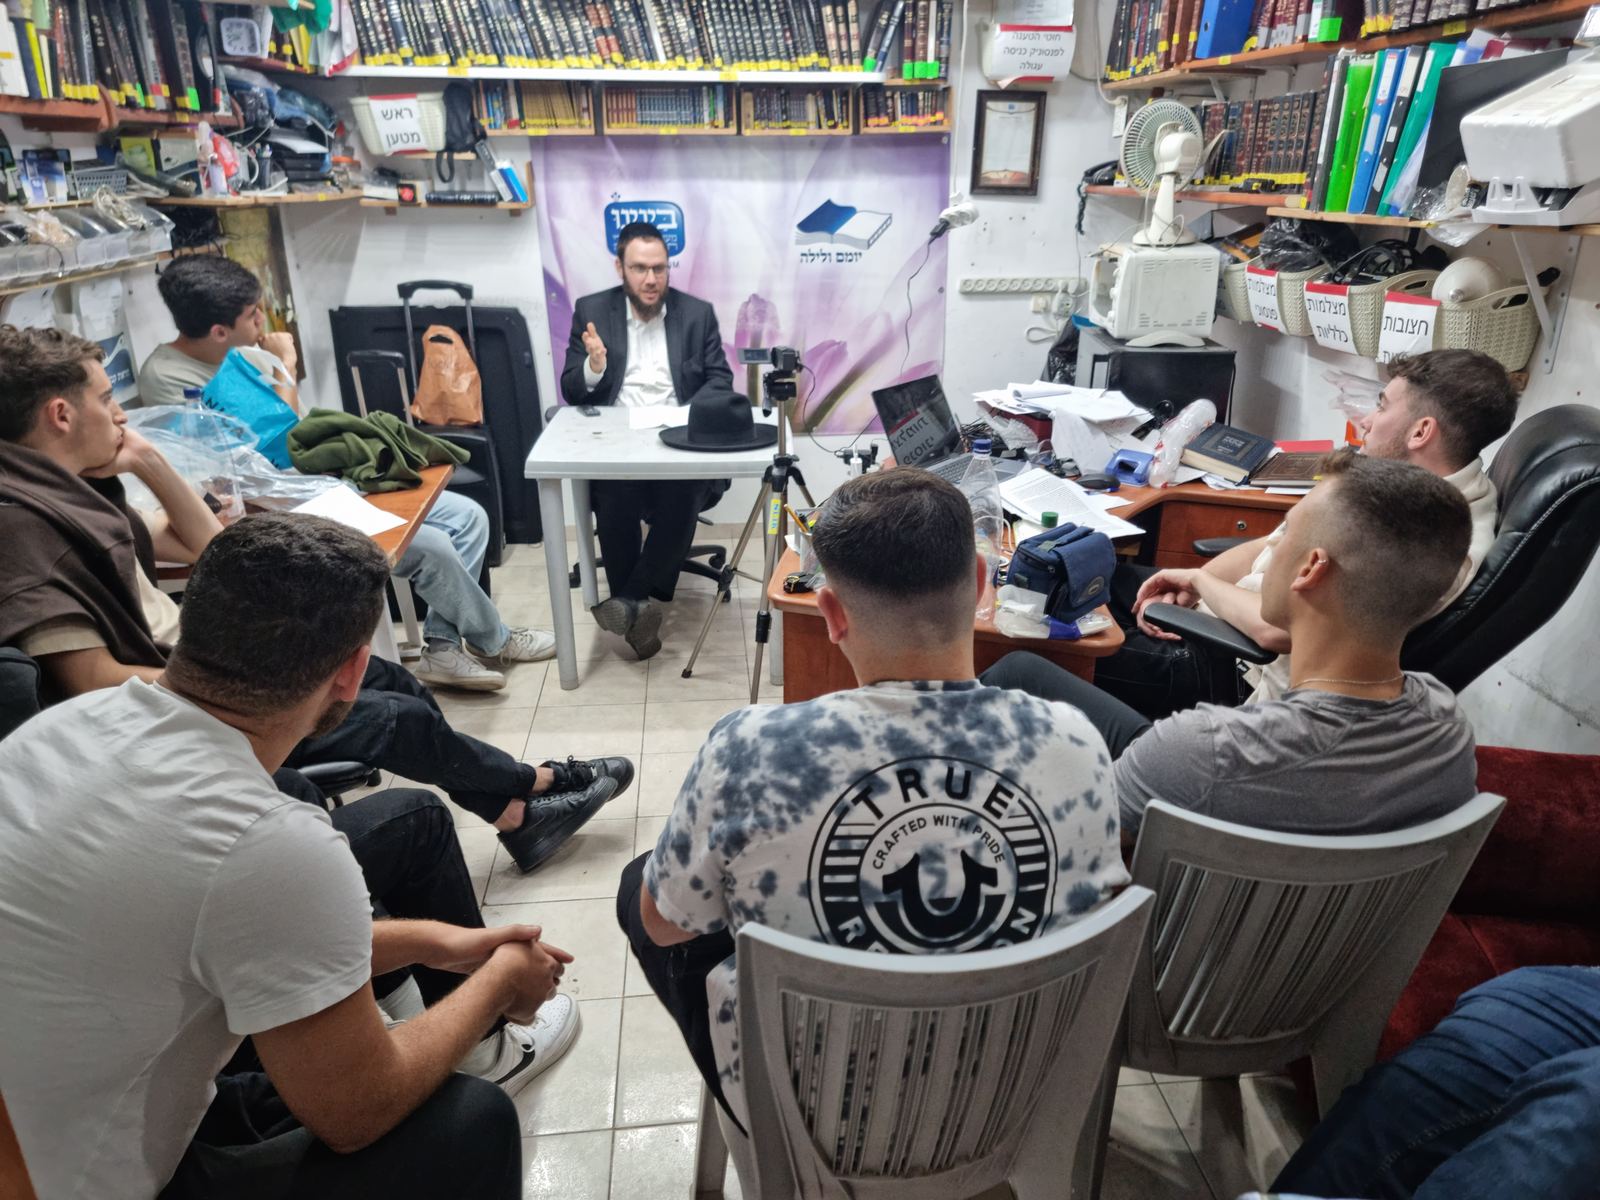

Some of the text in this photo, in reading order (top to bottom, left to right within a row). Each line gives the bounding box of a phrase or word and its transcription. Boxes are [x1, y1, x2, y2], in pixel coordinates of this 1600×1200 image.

[1003, 46, 1027, 55] כניסה
[1019, 61, 1043, 70] עגולה
[381, 107, 413, 120] ראש
[386, 131, 421, 148] מטען
[800, 248, 862, 263] יומם ולילה
[1307, 297, 1347, 316] מצלמות
[1316, 324, 1348, 343] כלליות
[1383, 315, 1429, 337] חצובות
[852, 766, 1015, 820] TRUE
[872, 814, 1006, 870] CRAFTED WITH PRIDE
